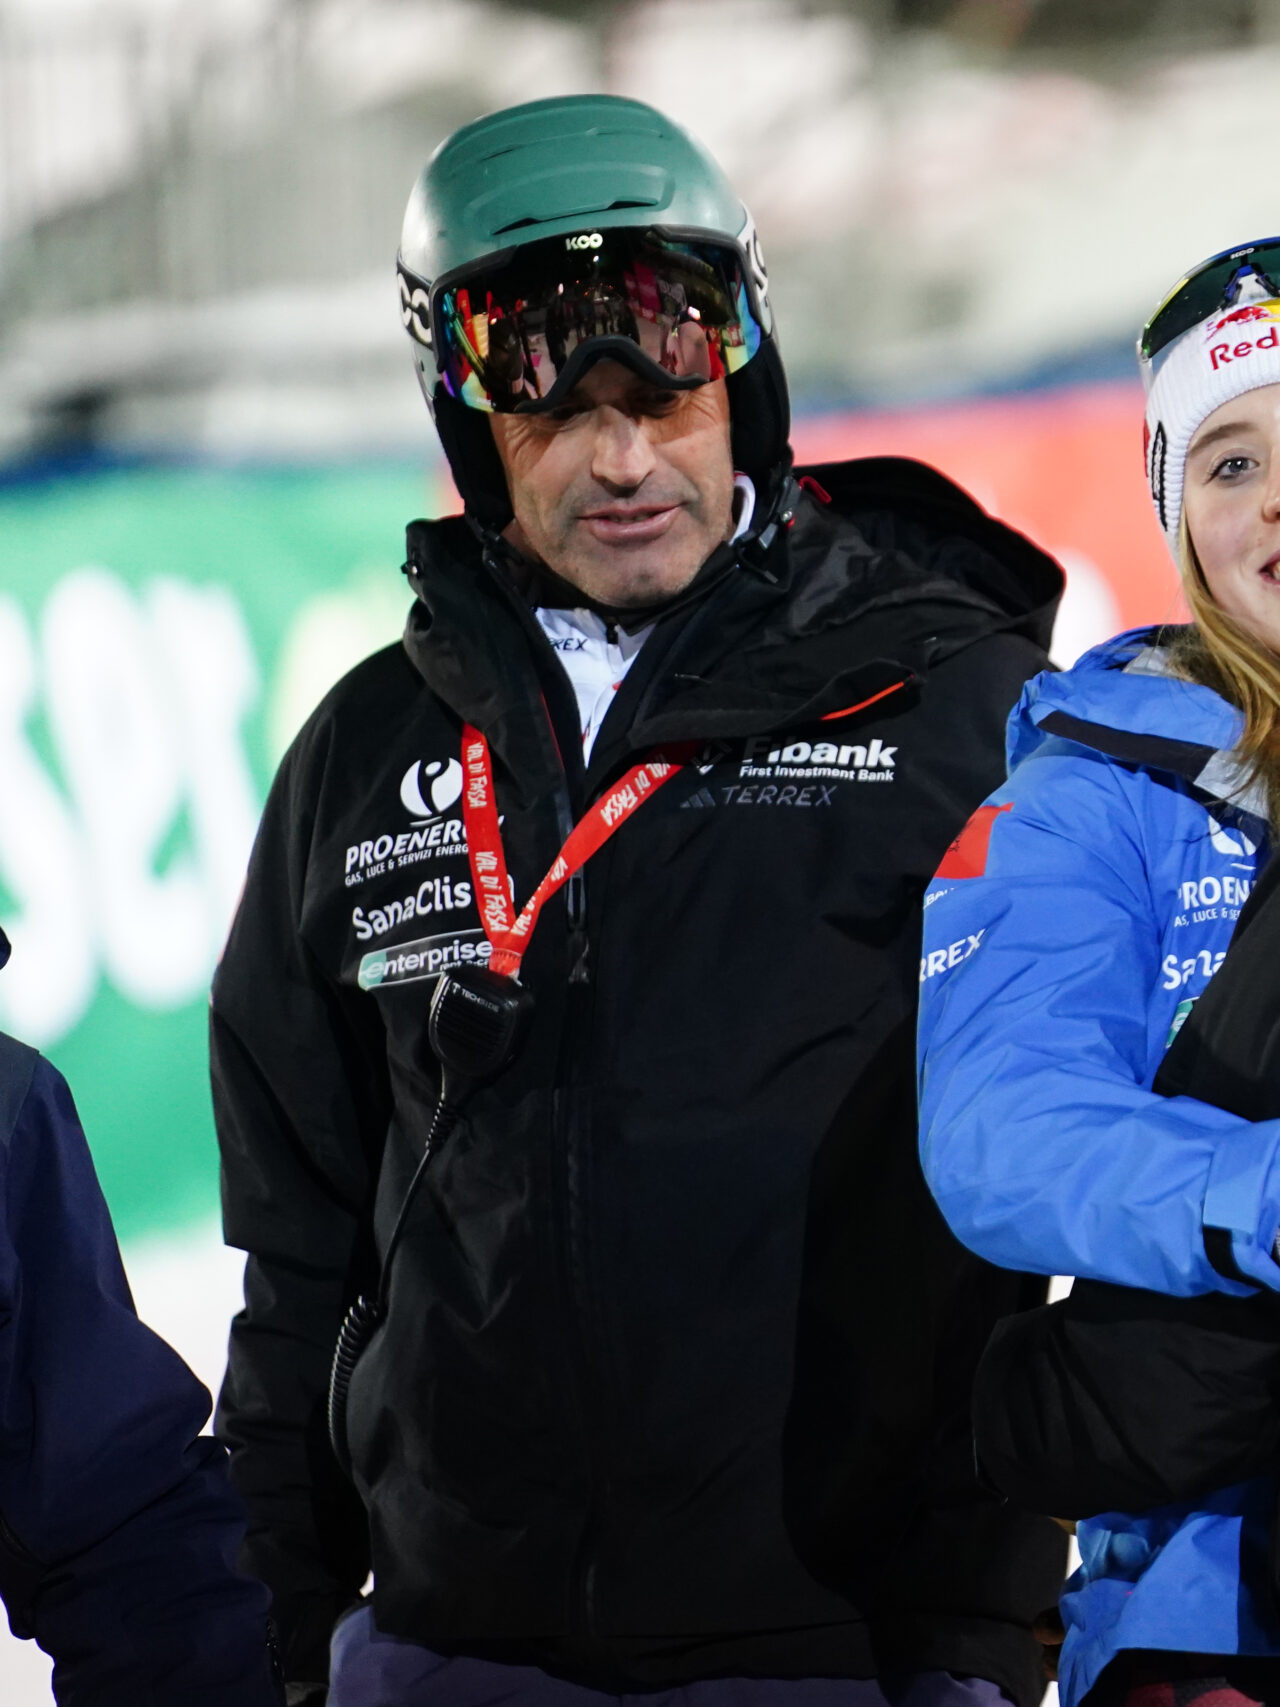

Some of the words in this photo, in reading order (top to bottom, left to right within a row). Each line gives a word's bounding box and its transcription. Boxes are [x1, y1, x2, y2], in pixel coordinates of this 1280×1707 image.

[565, 233, 603, 250] KOO
[1210, 326, 1280, 370] Red
[467, 741, 484, 762] VAL
[740, 765, 772, 778] First
[775, 765, 855, 780] Investment
[858, 769, 894, 781] Bank
[469, 775, 487, 808] FASSA
[600, 784, 638, 826] FASSA
[722, 785, 837, 806] TERREX
[345, 815, 504, 874] PROENER
[475, 851, 497, 873] VAL
[345, 871, 363, 888] GAS,
[366, 862, 385, 879] LUCE
[388, 860, 394, 871] &
[398, 848, 432, 867] SERVIZI
[435, 843, 469, 857] ENERG
[352, 875, 472, 940] SanaClis
[1178, 875, 1257, 911] ROEN
[483, 893, 511, 932] FASSA
[1174, 915, 1190, 927] AS,
[1193, 908, 1218, 923] LUCE
[1221, 907, 1228, 918] &
[360, 939, 493, 979] enterprise
